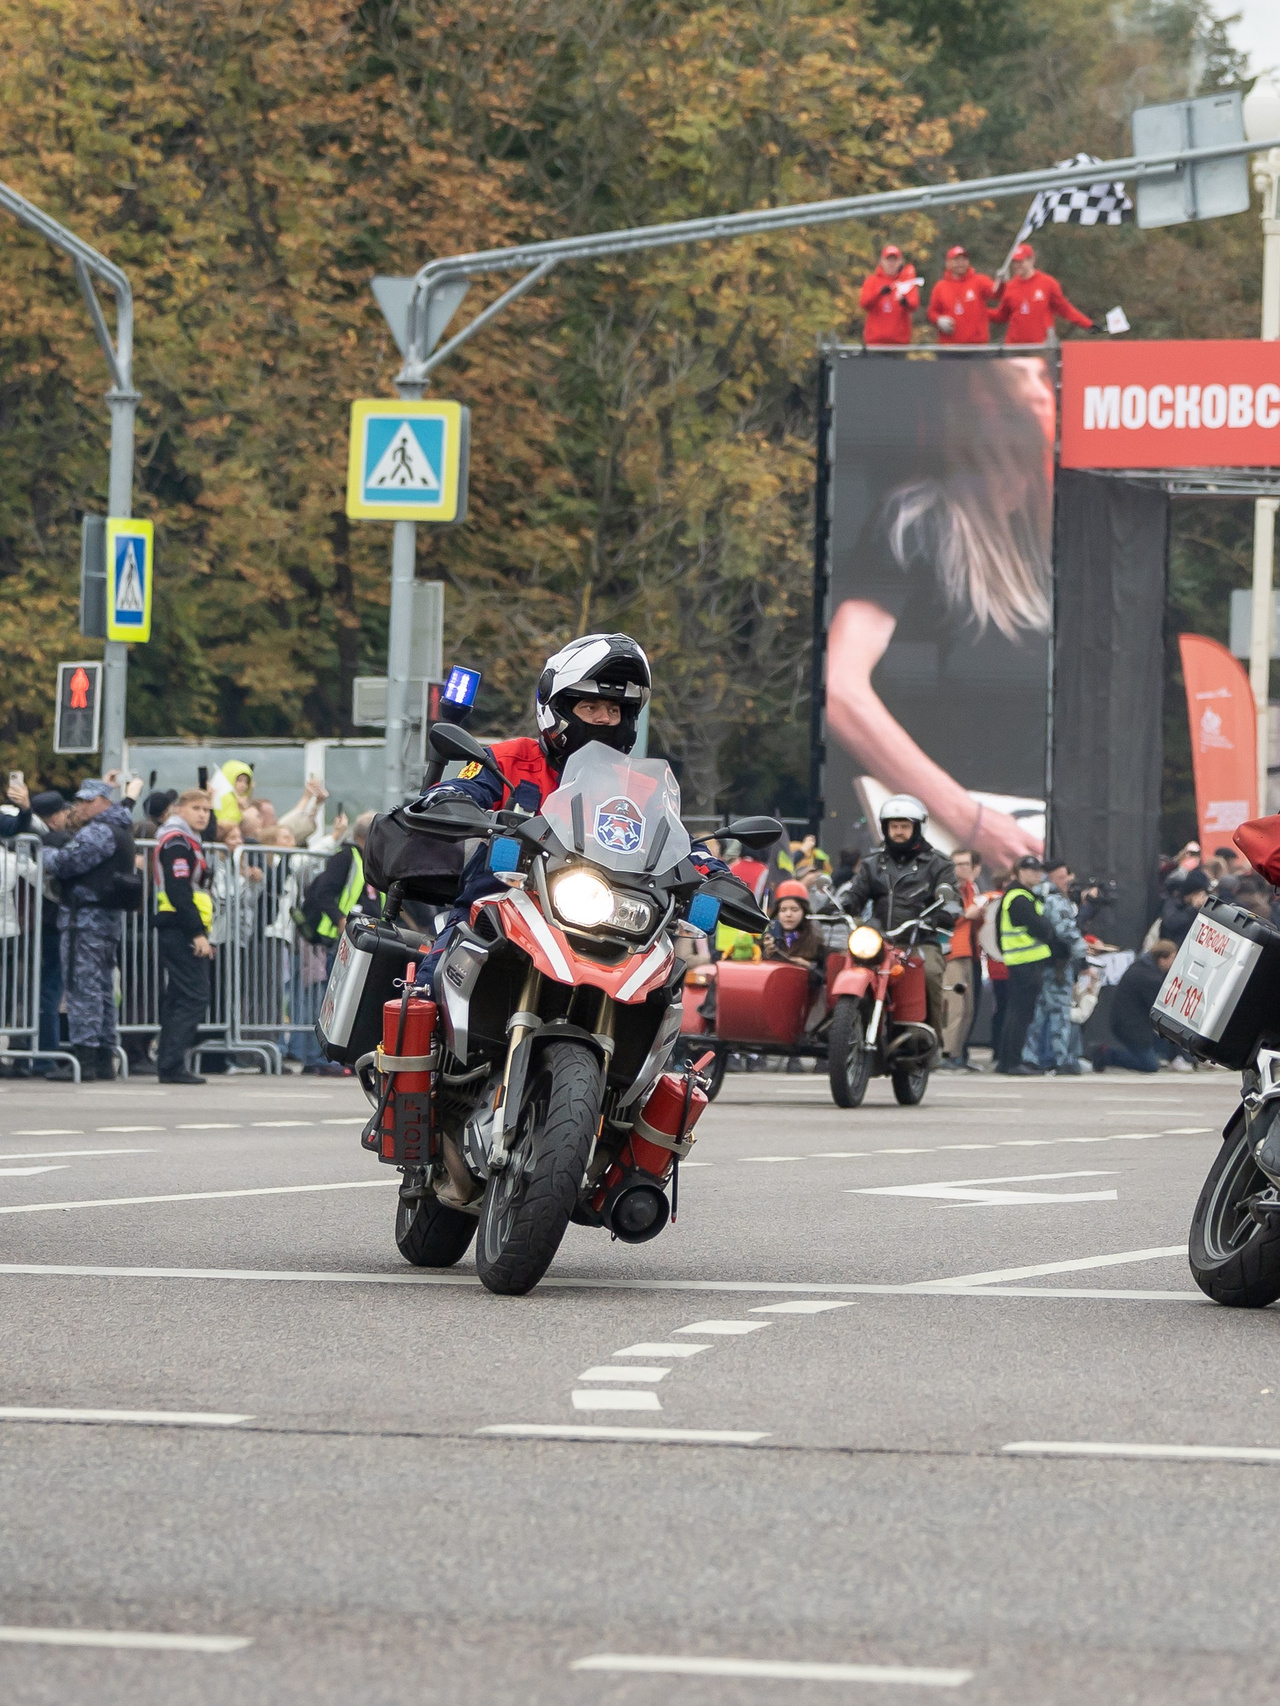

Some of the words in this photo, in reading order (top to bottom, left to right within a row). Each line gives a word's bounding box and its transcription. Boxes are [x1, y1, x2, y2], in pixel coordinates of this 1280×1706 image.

[1195, 922, 1231, 957] ТЕЛЕФОН
[446, 964, 465, 989] GS
[1164, 976, 1184, 1008] 01
[1180, 985, 1203, 1020] 101
[403, 1099, 421, 1160] ROLF
